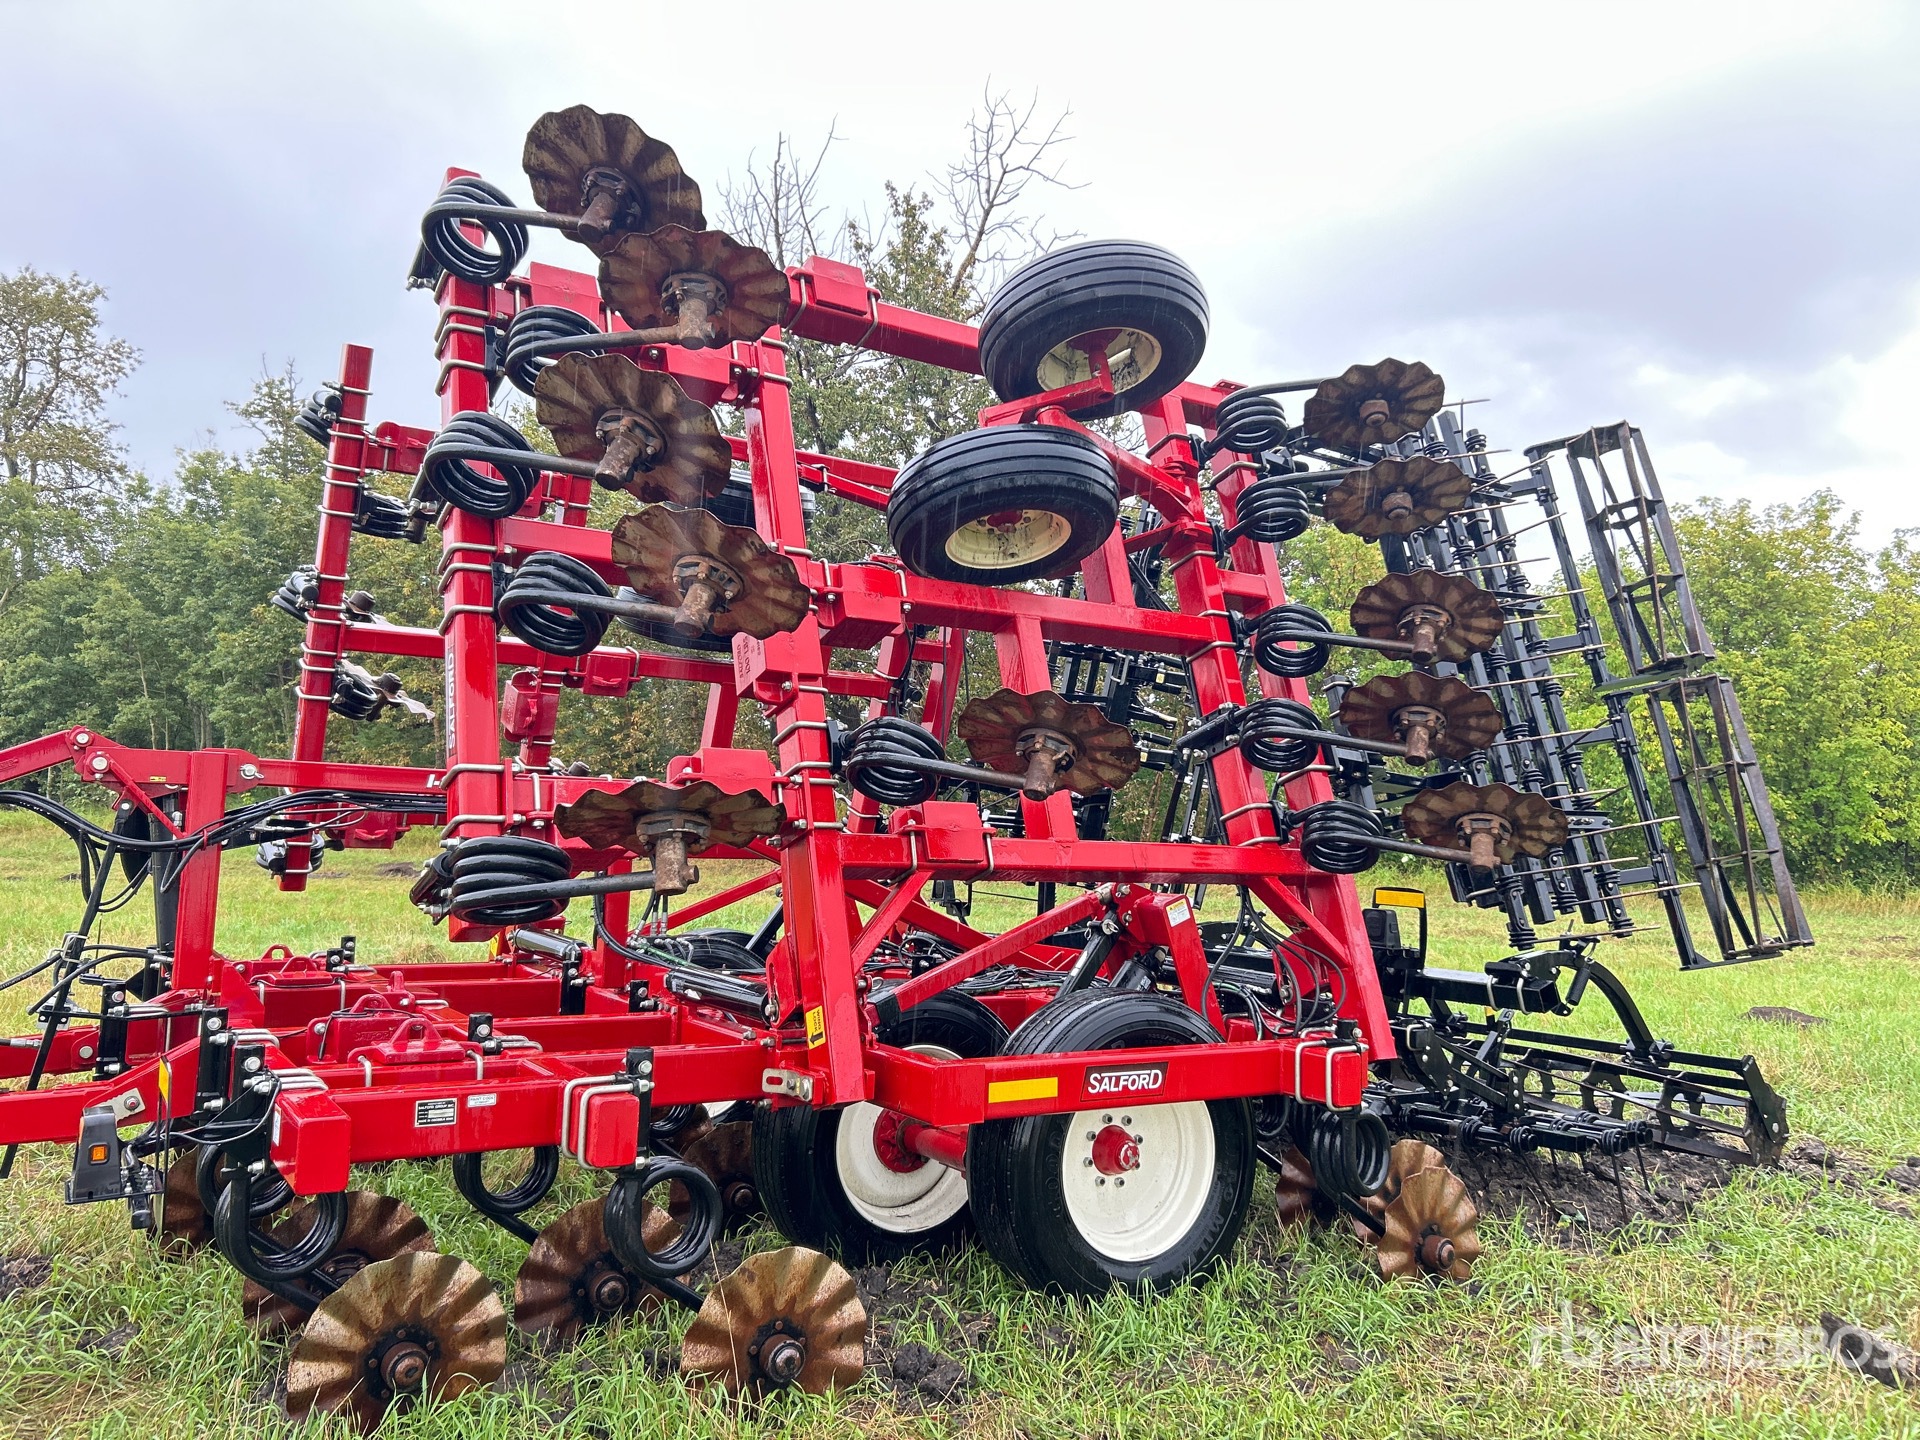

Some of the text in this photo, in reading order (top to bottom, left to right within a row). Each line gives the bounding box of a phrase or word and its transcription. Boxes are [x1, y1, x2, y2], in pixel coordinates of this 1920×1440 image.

[448, 652, 456, 749] SALFORD
[1187, 809, 1197, 836] SALFORD
[1088, 1069, 1163, 1094] SALFORD
